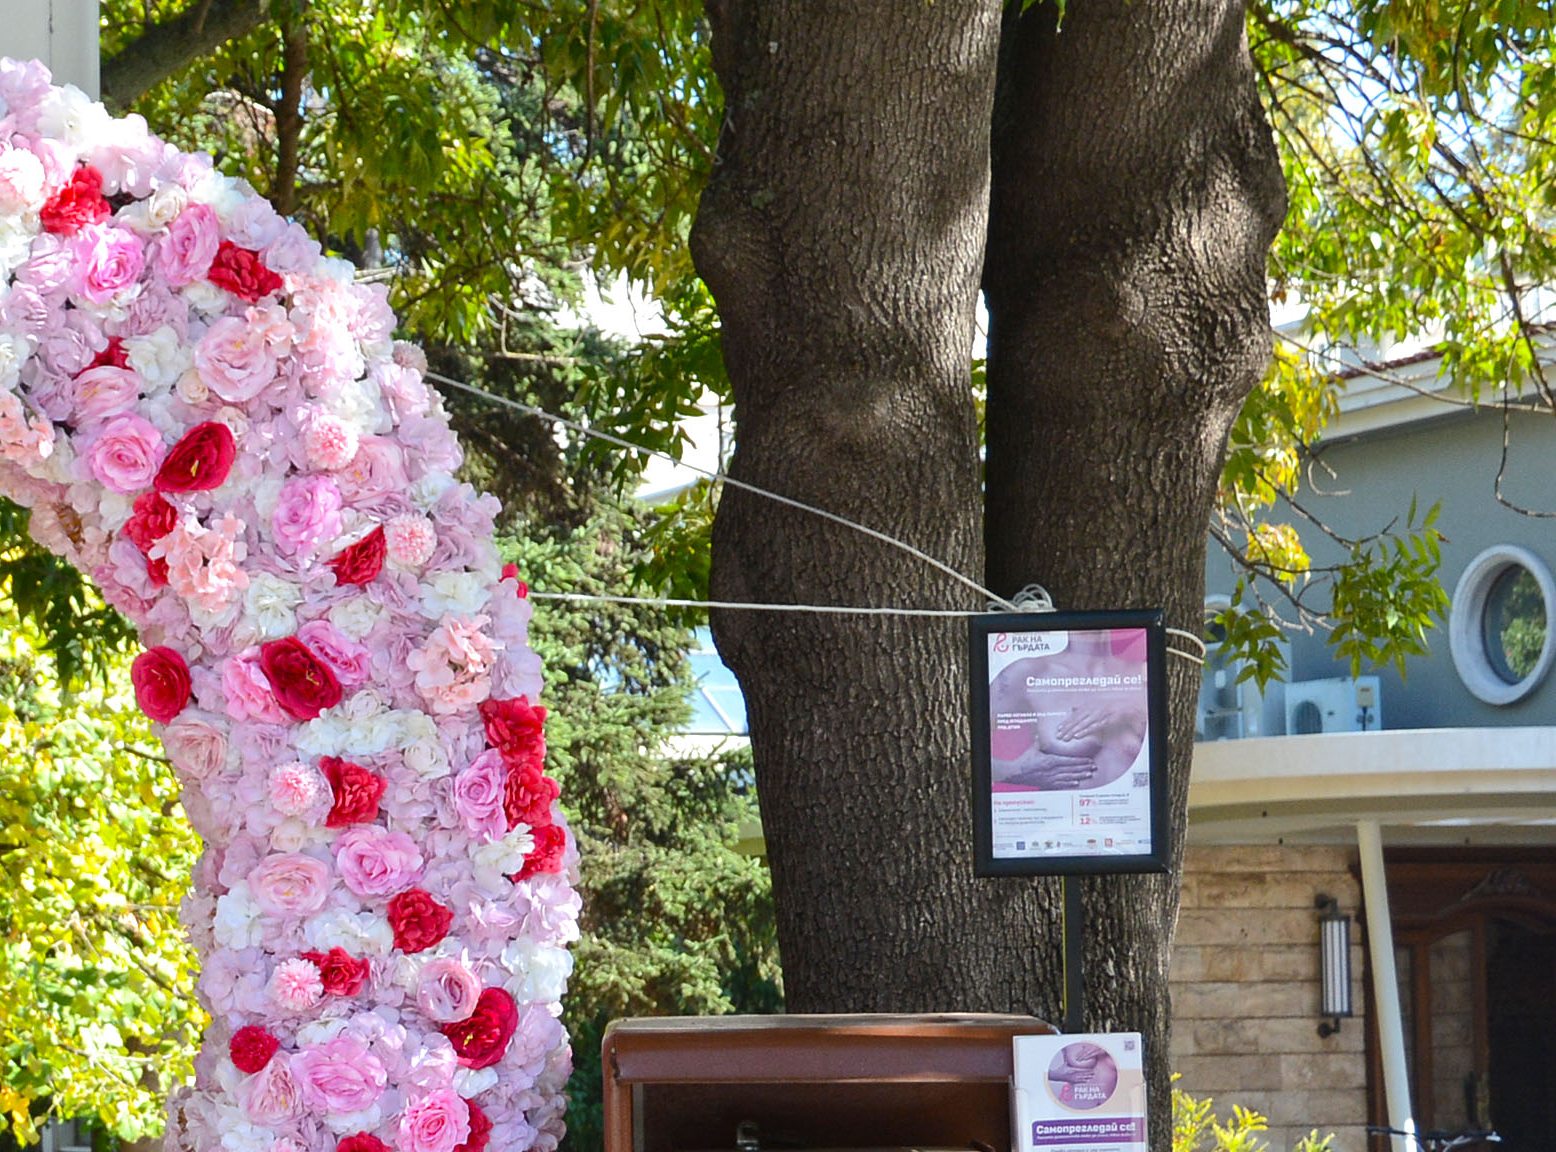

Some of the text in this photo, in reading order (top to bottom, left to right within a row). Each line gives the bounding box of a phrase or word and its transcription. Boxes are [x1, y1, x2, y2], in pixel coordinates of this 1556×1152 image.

[1030, 635, 1043, 643] НА
[1012, 643, 1051, 652] ГЪРДАТА
[1026, 674, 1142, 688] Самопрегледай се!
[1036, 1123, 1118, 1134] Самопрегледай
